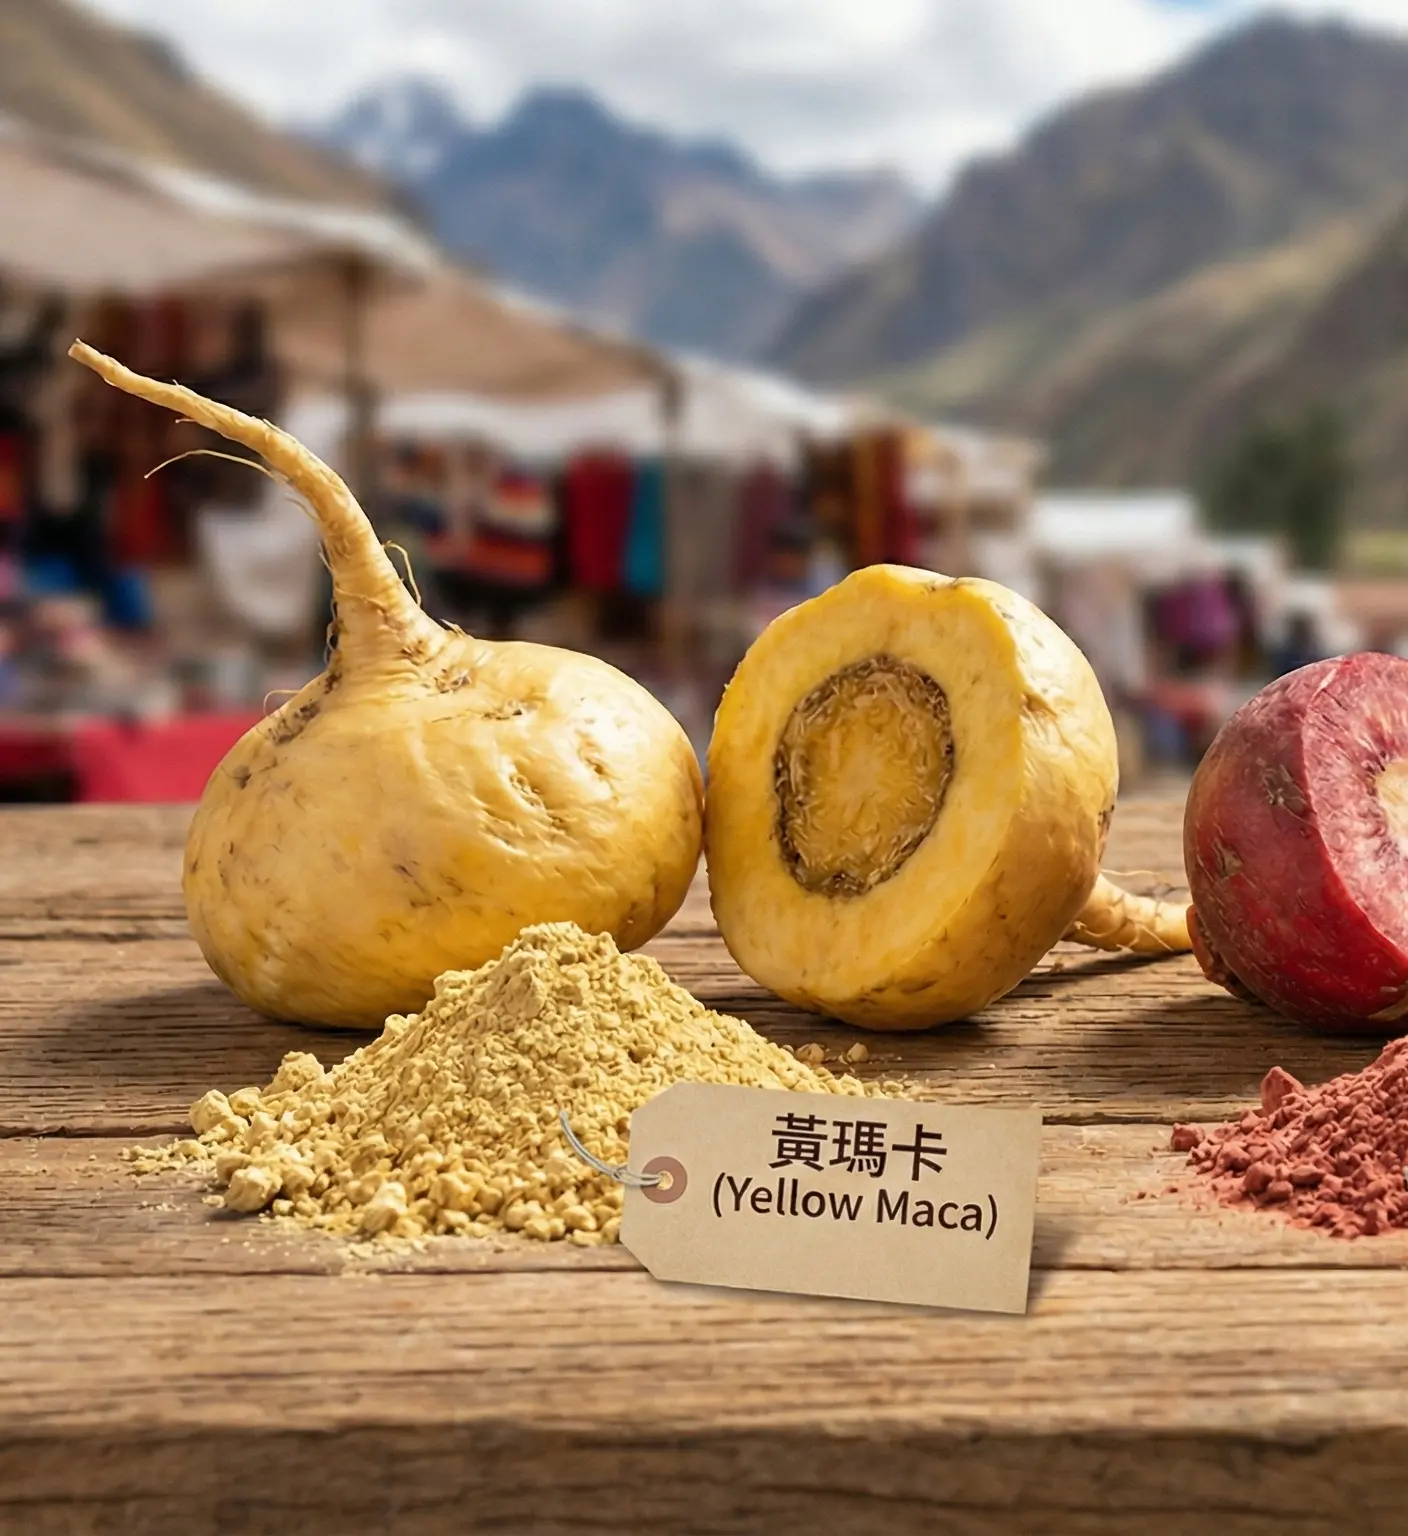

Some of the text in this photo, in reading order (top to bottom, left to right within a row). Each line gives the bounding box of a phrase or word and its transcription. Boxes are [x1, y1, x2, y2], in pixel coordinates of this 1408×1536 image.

[768, 1112, 949, 1182] 黃瑪卡
[712, 1171, 999, 1241] (Yellow Maca)
